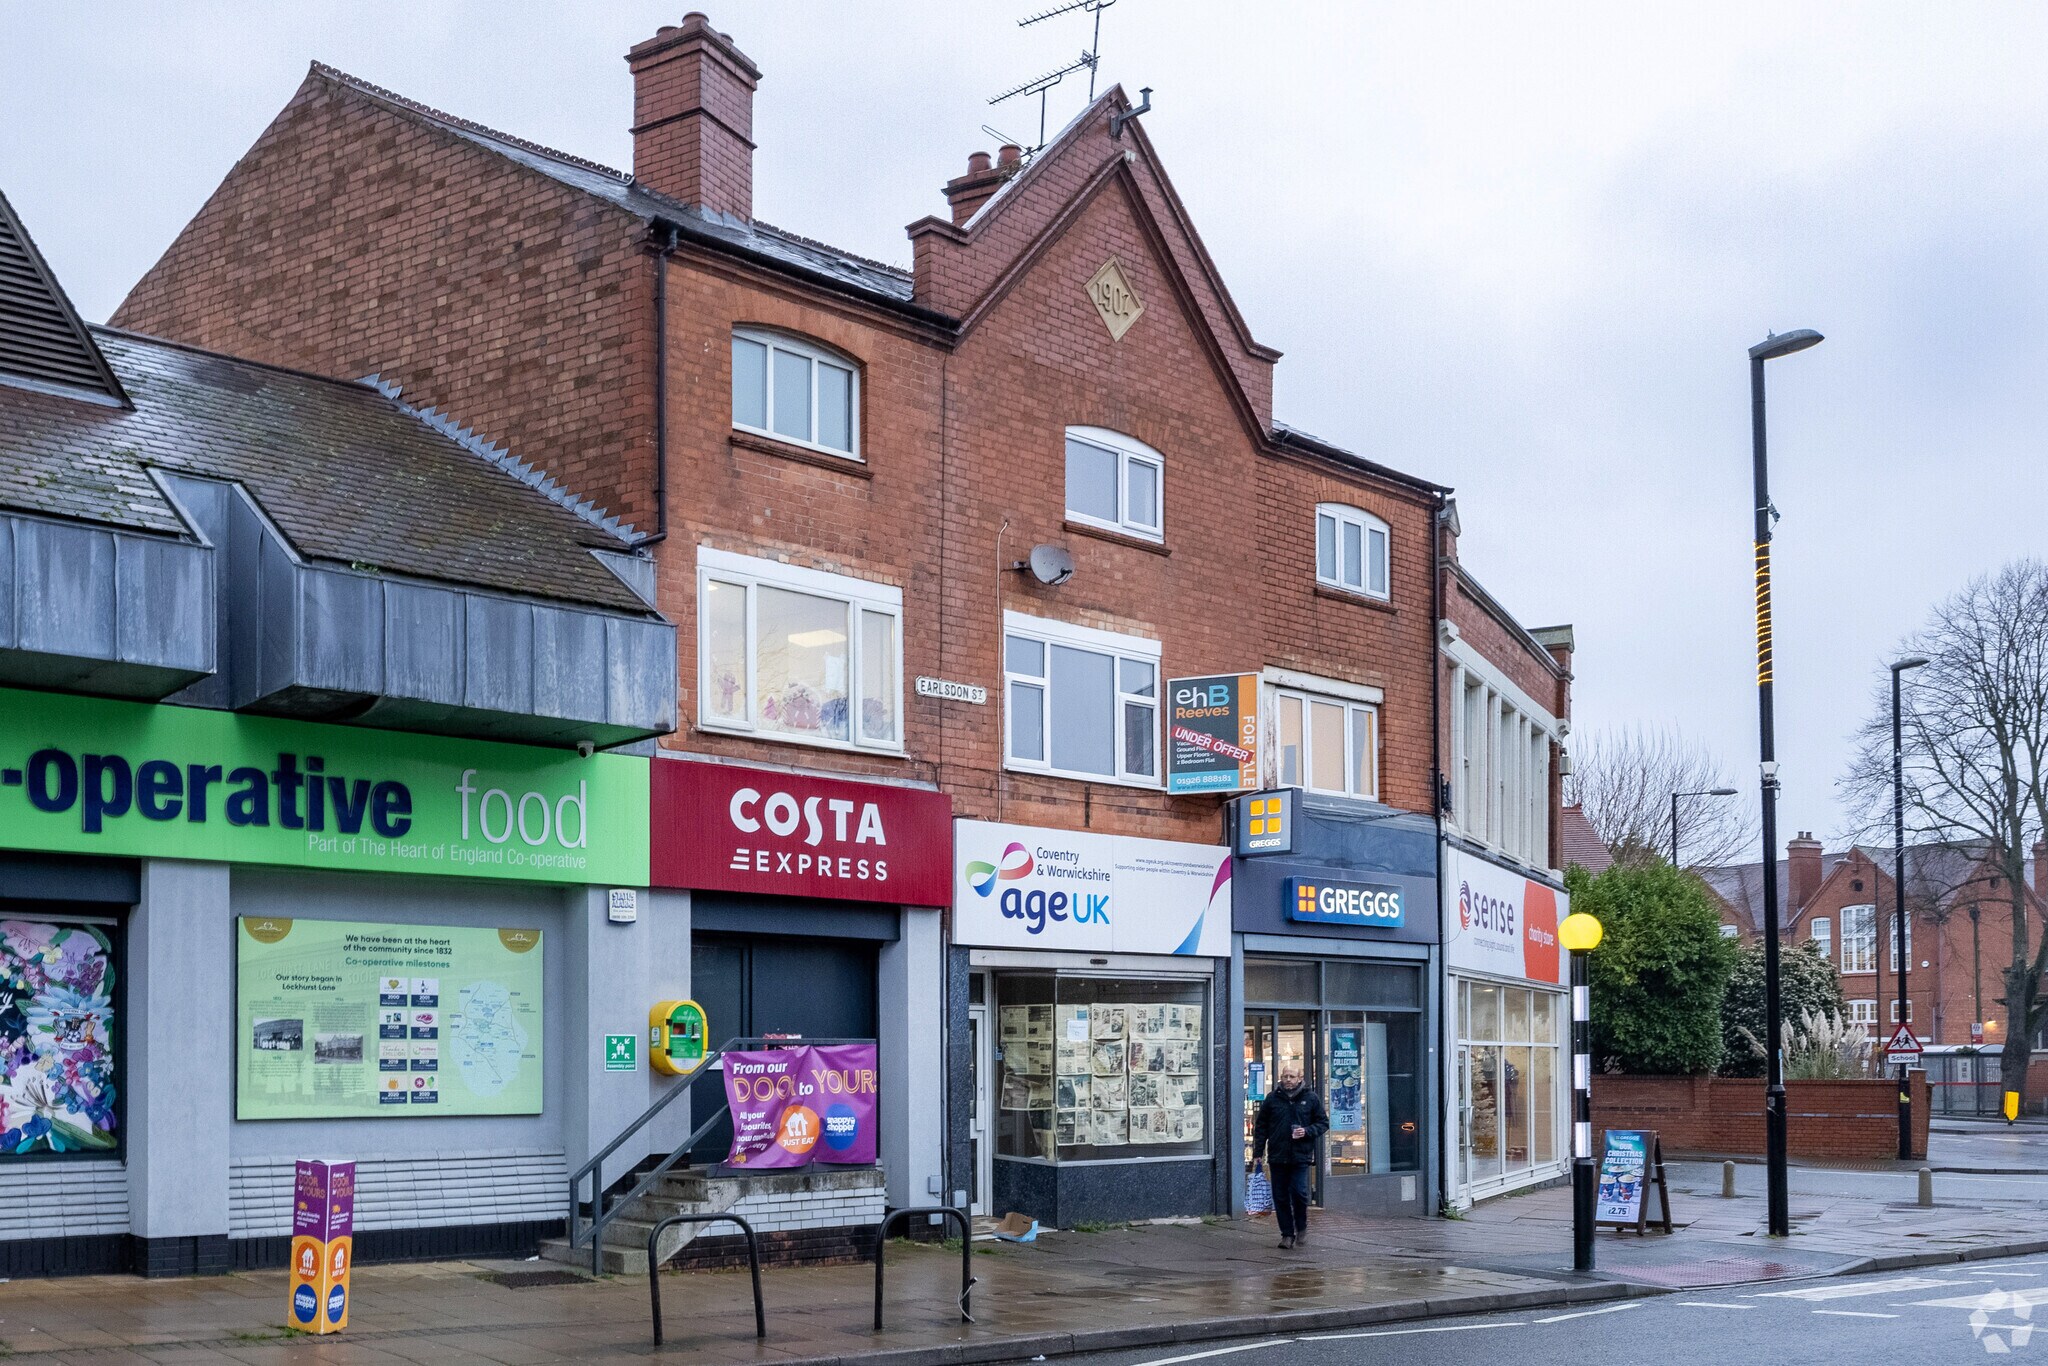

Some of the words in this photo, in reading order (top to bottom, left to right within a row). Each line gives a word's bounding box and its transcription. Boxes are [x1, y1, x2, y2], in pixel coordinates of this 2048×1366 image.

[1096, 281, 1130, 317] 1907
[921, 680, 969, 699] EARLSDON
[972, 689, 983, 700] ST
[1176, 684, 1230, 708] ehB
[1176, 706, 1230, 719] Reeves
[1243, 715, 1256, 745] FOR
[1175, 727, 1212, 748] UNDER
[1213, 741, 1249, 761] OFFER
[1243, 750, 1256, 787] ALE
[1176, 776, 1200, 785] 01926
[1203, 775, 1232, 783] 888181
[455, 769, 587, 849] food
[730, 787, 887, 847] COSTA
[309, 834, 338, 852] Part
[343, 839, 356, 853] of
[360, 838, 386, 856] The
[391, 842, 428, 860] Heart
[432, 843, 445, 859] of
[451, 845, 502, 866] England
[507, 849, 586, 869] Co-operative
[1249, 838, 1281, 849] GREGGS
[1037, 846, 1080, 865] Coventry
[756, 850, 888, 882] EXPRESS
[1037, 864, 1045, 876] &
[1047, 865, 1111, 882] Warwickshire
[1000, 887, 1068, 935] age
[1073, 892, 1110, 925] UK
[1319, 887, 1400, 919] GREGGS
[1474, 892, 1514, 936] sense
[346, 934, 358, 942] We
[361, 935, 381, 943] have
[382, 936, 402, 944] been
[415, 937, 428, 945] the
[429, 937, 450, 945] heart
[343, 944, 351, 952] of
[353, 944, 366, 952] the
[368, 945, 411, 955] community
[414, 946, 433, 954] since
[436, 947, 452, 955] 1832
[346, 957, 404, 968] Co-operative
[406, 959, 450, 968] milestones
[276, 973, 289, 981] Our
[292, 974, 309, 982] story
[311, 975, 334, 983] began
[733, 1063, 764, 1074] From
[767, 1062, 787, 1073] our
[1334, 1058, 1358, 1066] COLLECTION
[799, 1082, 814, 1096] to
[748, 1112, 766, 1121] your
[783, 1138, 800, 1147] JUST
[802, 1136, 814, 1145] EAT
